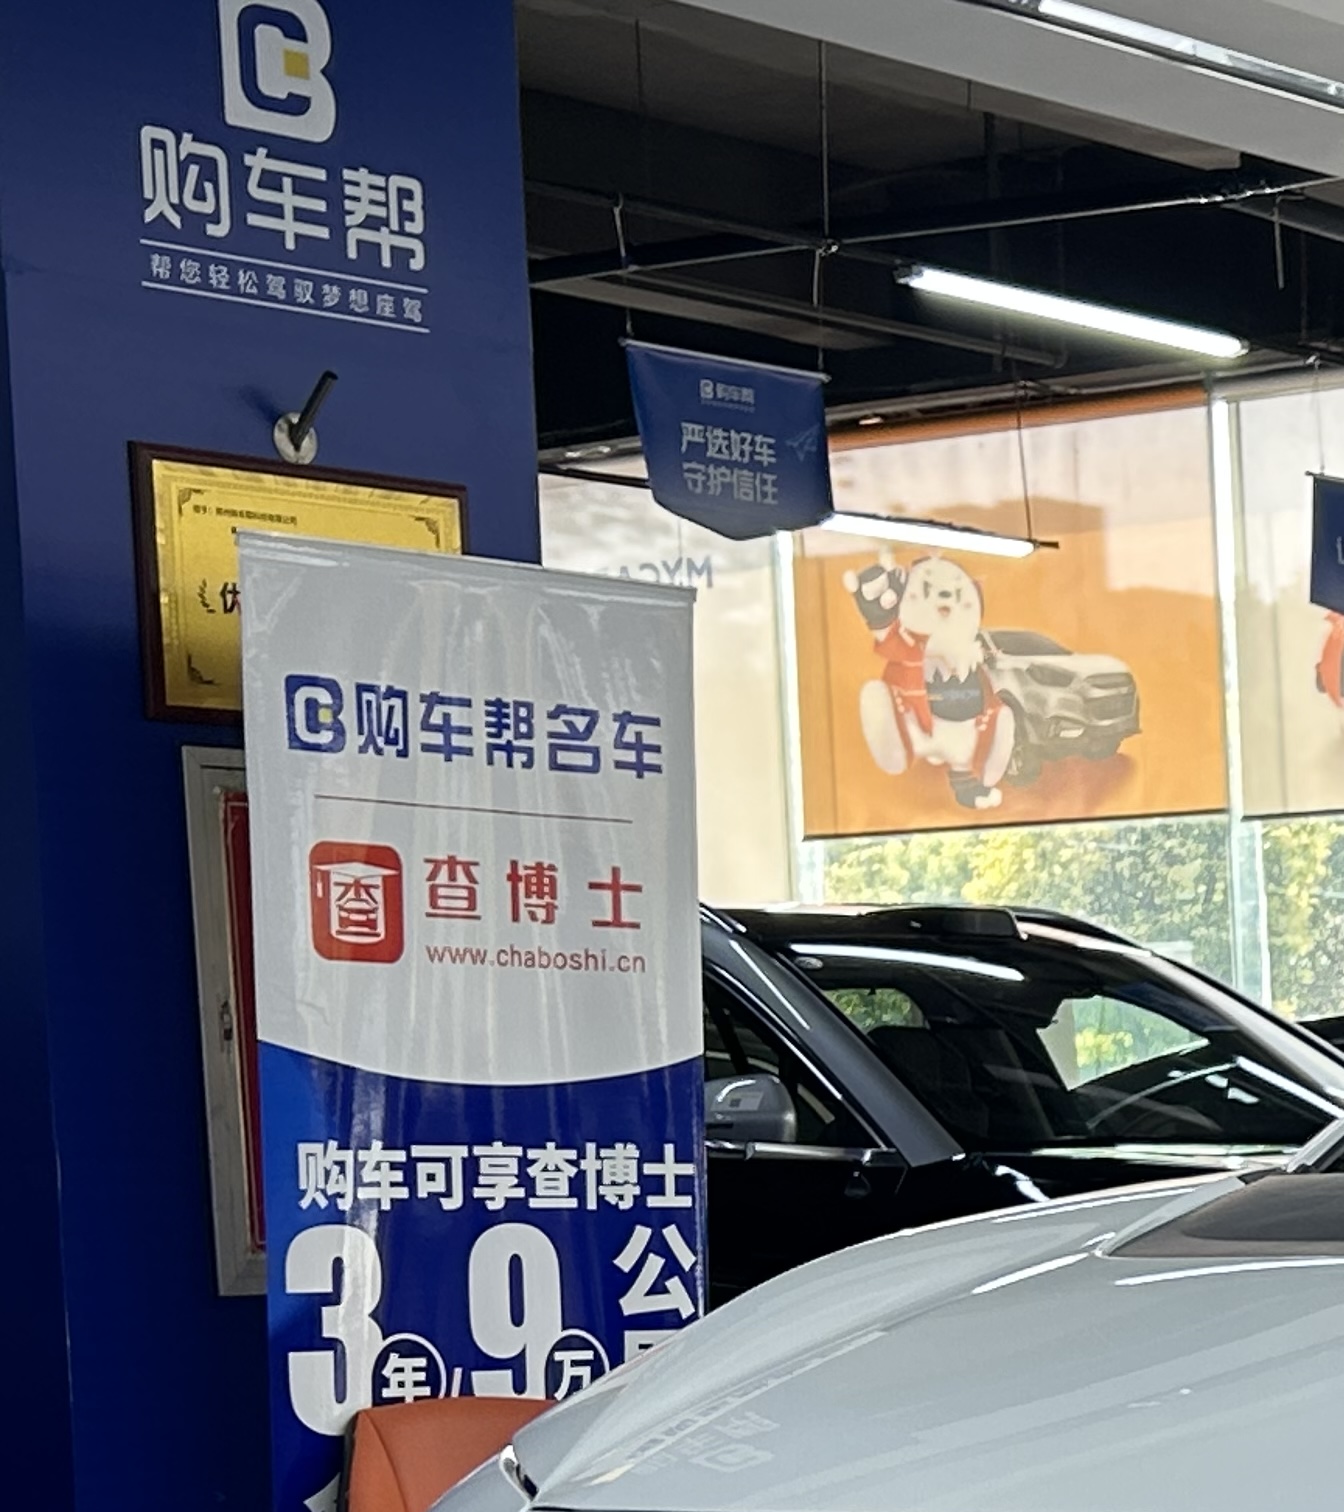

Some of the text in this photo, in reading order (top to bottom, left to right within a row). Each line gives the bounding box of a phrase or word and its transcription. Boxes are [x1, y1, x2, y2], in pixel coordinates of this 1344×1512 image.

[139, 125, 426, 272] 购车帮
[150, 252, 423, 323] 帮您轻松驾驭梦想座驾
[681, 421, 777, 467] 严选好车
[682, 461, 779, 505] 守护信任
[355, 681, 663, 780] 购车帮名车
[423, 854, 643, 930] 查博士
[425, 944, 647, 975] www.chaboshi.cn
[296, 1139, 696, 1211] 购车可享查博士
